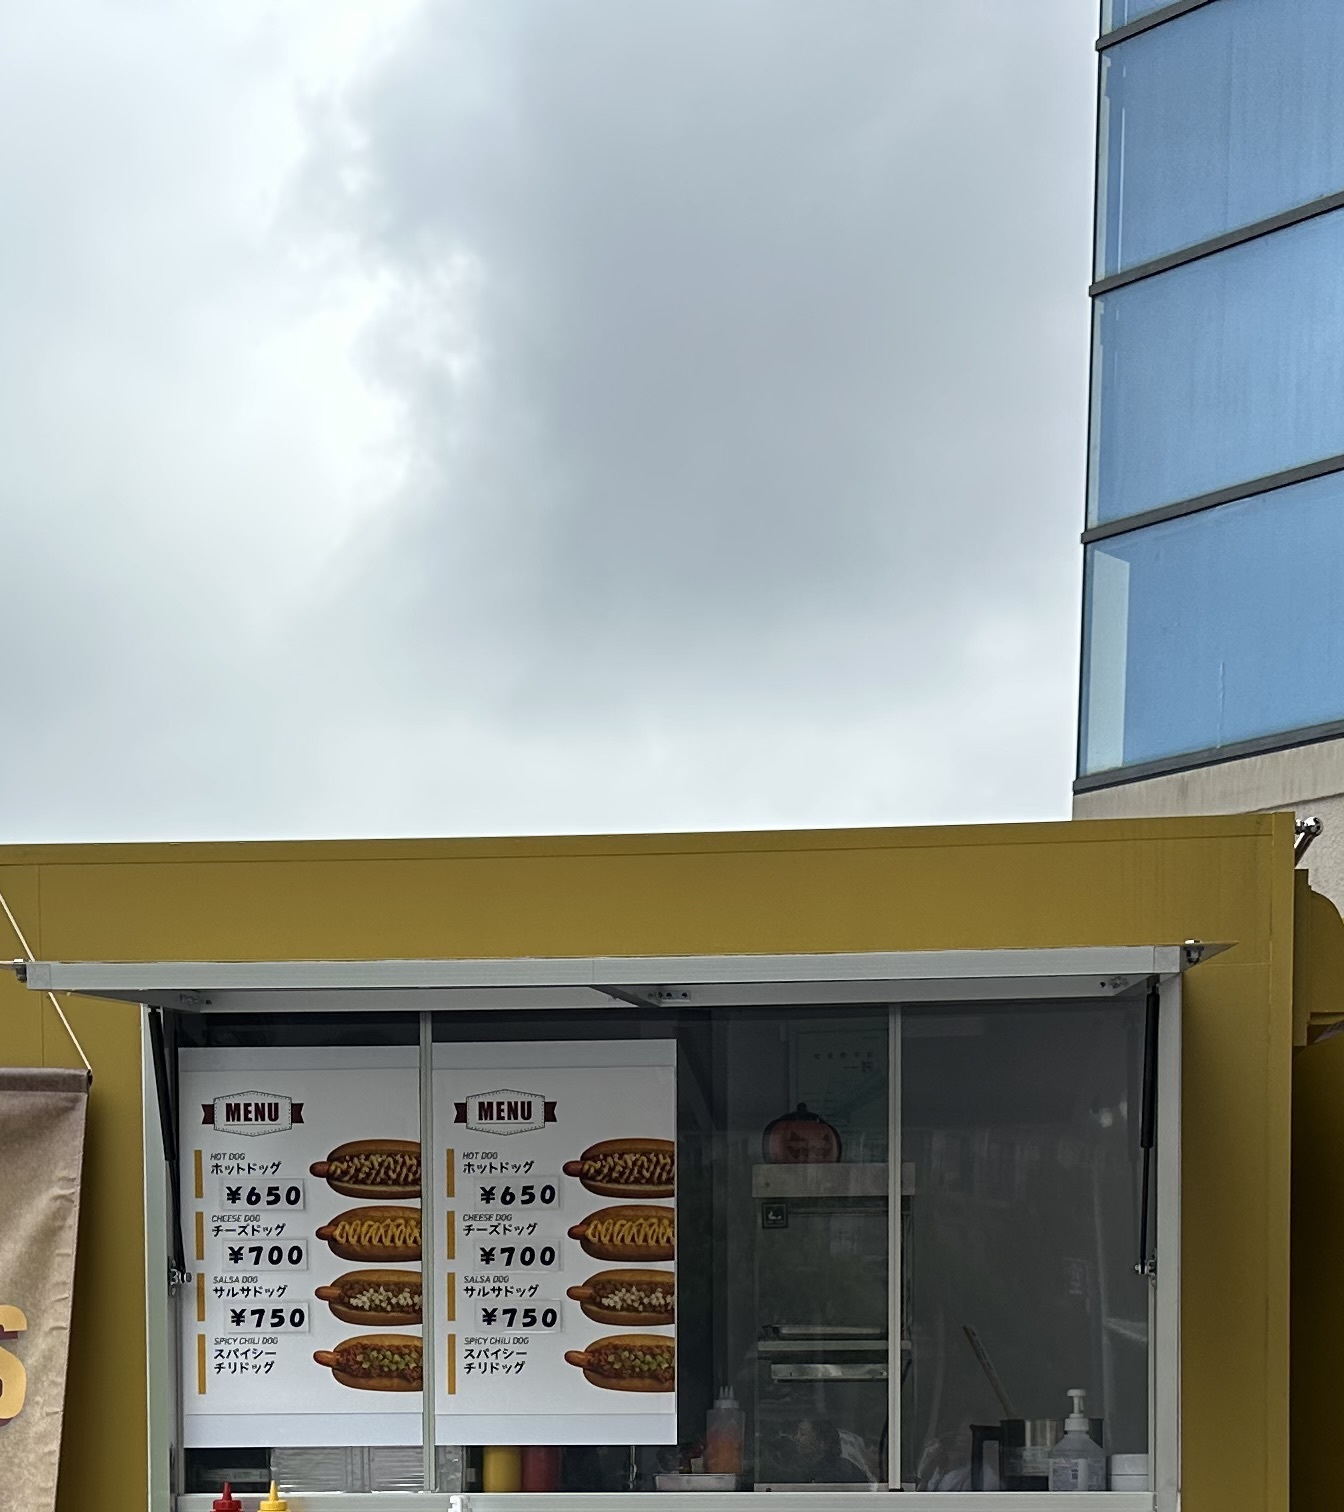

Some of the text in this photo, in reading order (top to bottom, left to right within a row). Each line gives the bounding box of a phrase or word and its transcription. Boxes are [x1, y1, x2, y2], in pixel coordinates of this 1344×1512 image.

[225, 1102, 279, 1122] MENU
[478, 1101, 532, 1121] MENU
[210, 1152, 245, 1161] HOT DOG
[463, 1151, 498, 1160] HOT DOG
[210, 1161, 281, 1175] ホットドッグ
[463, 1160, 534, 1174] ホットドッグ
[226, 1185, 301, 1206] ¥650
[480, 1184, 556, 1205] ¥650
[244, 1214, 260, 1222] DOG
[463, 1214, 512, 1222] CHEESE DOG
[212, 1223, 286, 1237] チーズドッグ
[463, 1222, 538, 1236] チーズドッグ
[228, 1245, 303, 1266] ¥700
[480, 1246, 556, 1267] ¥700
[213, 1275, 240, 1284] SALSA
[464, 1275, 491, 1284] SALSA
[213, 1285, 288, 1298] サルサドッグ
[464, 1284, 539, 1298] サルサドッグ
[230, 1308, 305, 1328] ¥750
[482, 1308, 557, 1328] ¥750
[214, 1348, 277, 1360] スパイシー
[464, 1348, 527, 1360] スパイシー
[214, 1361, 275, 1375] チリドッグ
[464, 1361, 525, 1375] チリドッグ
